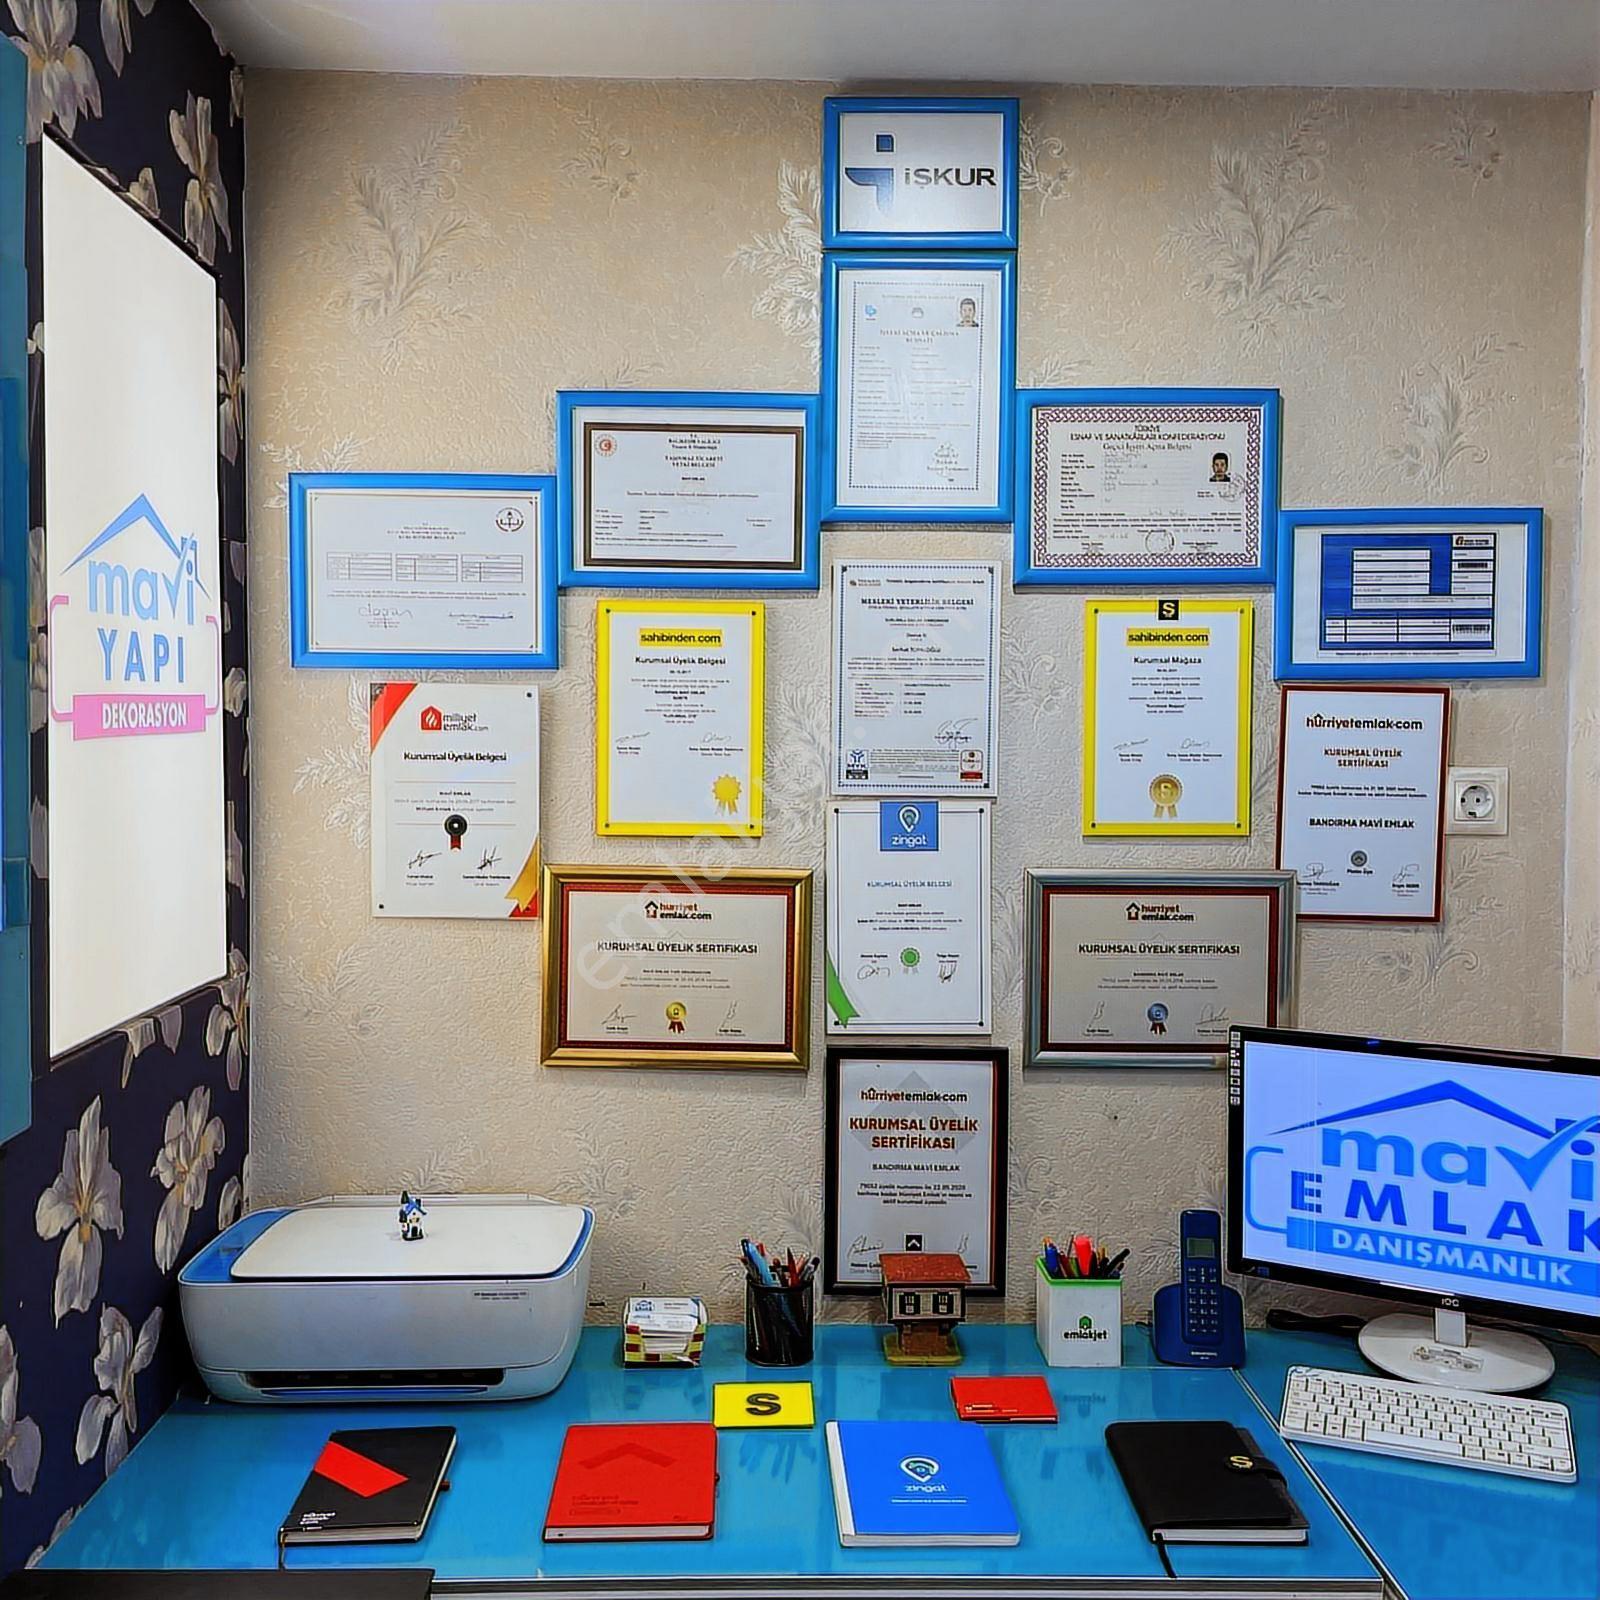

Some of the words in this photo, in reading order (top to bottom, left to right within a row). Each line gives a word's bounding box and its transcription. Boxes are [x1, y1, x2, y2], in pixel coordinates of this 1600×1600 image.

[97, 627, 185, 683] YAPI
[102, 701, 187, 730] DEKORASYON
[404, 751, 447, 761] Kurumsal
[1324, 748, 1370, 758] KURUMSAL
[1309, 817, 1358, 828] BANDIRMA
[1359, 817, 1383, 829] MAVİ
[1384, 819, 1415, 829] EMLAK
[891, 833, 929, 848] zingat
[597, 941, 655, 952] KURUMSAL
[1078, 943, 1137, 954] KURUMSAL
[849, 1117, 927, 1131] KURUMSAL
[929, 1115, 979, 1132] ÜYELİK
[871, 1133, 956, 1149] SERTİFİKASI
[1320, 1114, 1600, 1203] mavi
[1290, 1169, 1600, 1255] EMLAK
[1331, 1227, 1575, 1287] DANIŞMANLIK
[1063, 1327, 1108, 1342] emlakjet
[745, 1392, 782, 1416] S
